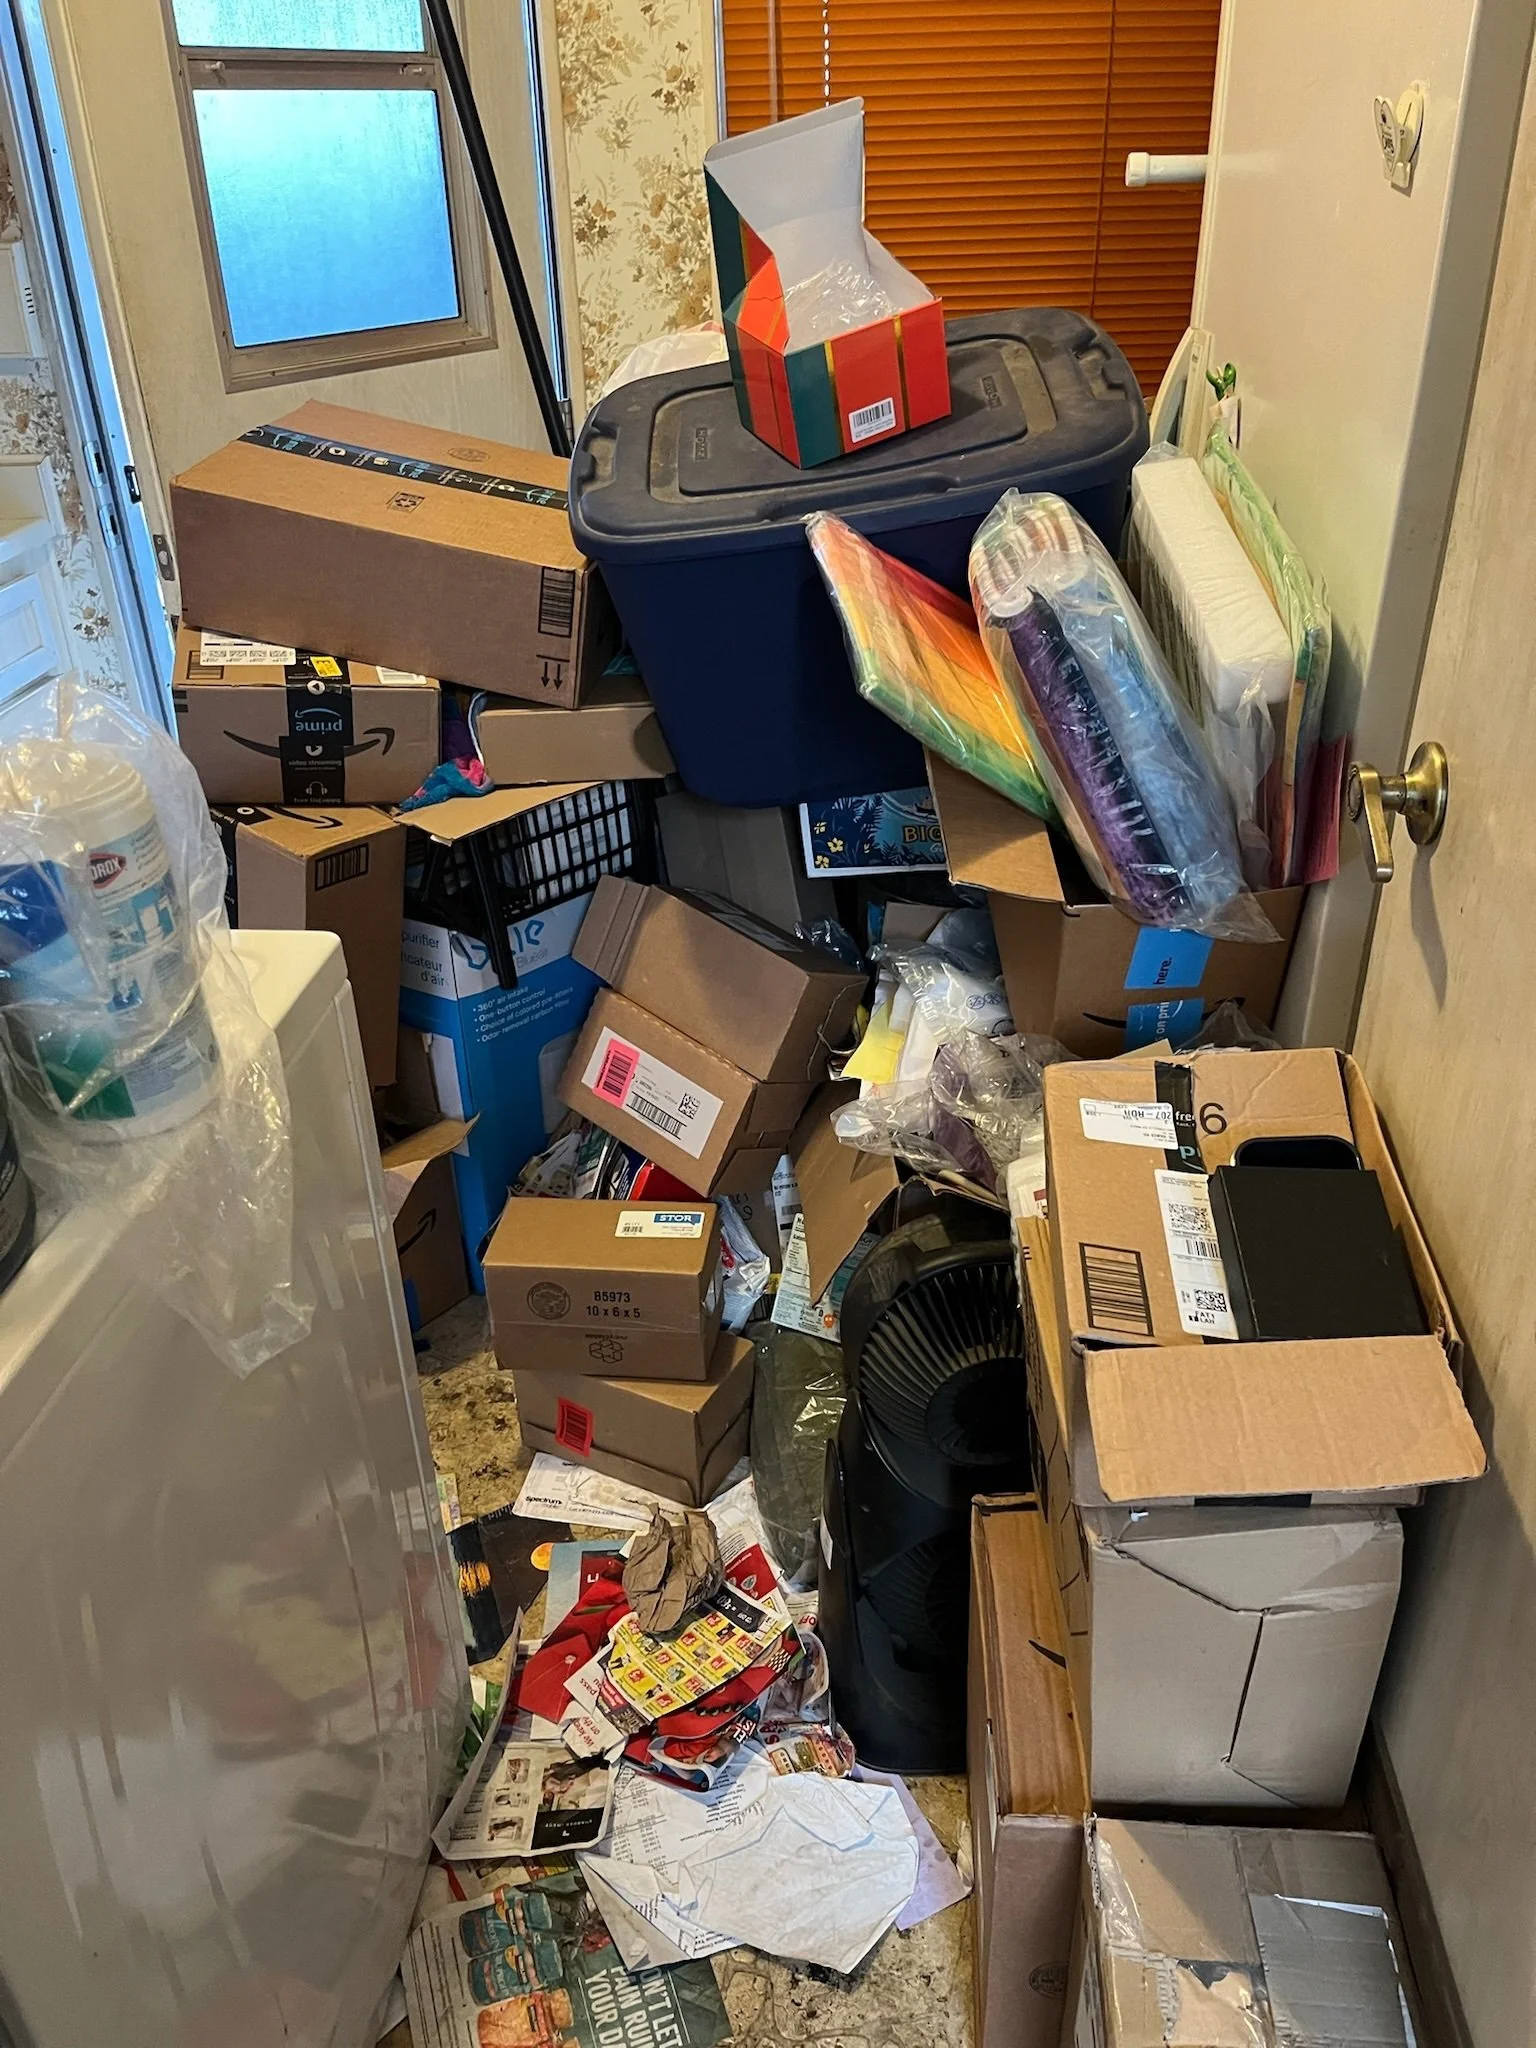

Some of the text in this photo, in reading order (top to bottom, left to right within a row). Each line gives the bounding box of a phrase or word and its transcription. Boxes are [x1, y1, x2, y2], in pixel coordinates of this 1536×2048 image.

[295, 718, 343, 735] prime
[402, 931, 440, 950] purifier
[420, 970, 445, 987] d'air
[1152, 957, 1174, 985] here.
[480, 1014, 506, 1032] Choice
[659, 1213, 693, 1223] STOR
[593, 1290, 632, 1303] B5973
[586, 1305, 641, 1319] 10 x 6 x 5
[525, 1496, 562, 1506] Spectrum
[579, 1677, 598, 1696] pass
[584, 1968, 628, 2048] YOUR D
[639, 1966, 684, 2048] ON'T LET
[623, 2009, 656, 2048] RUI
